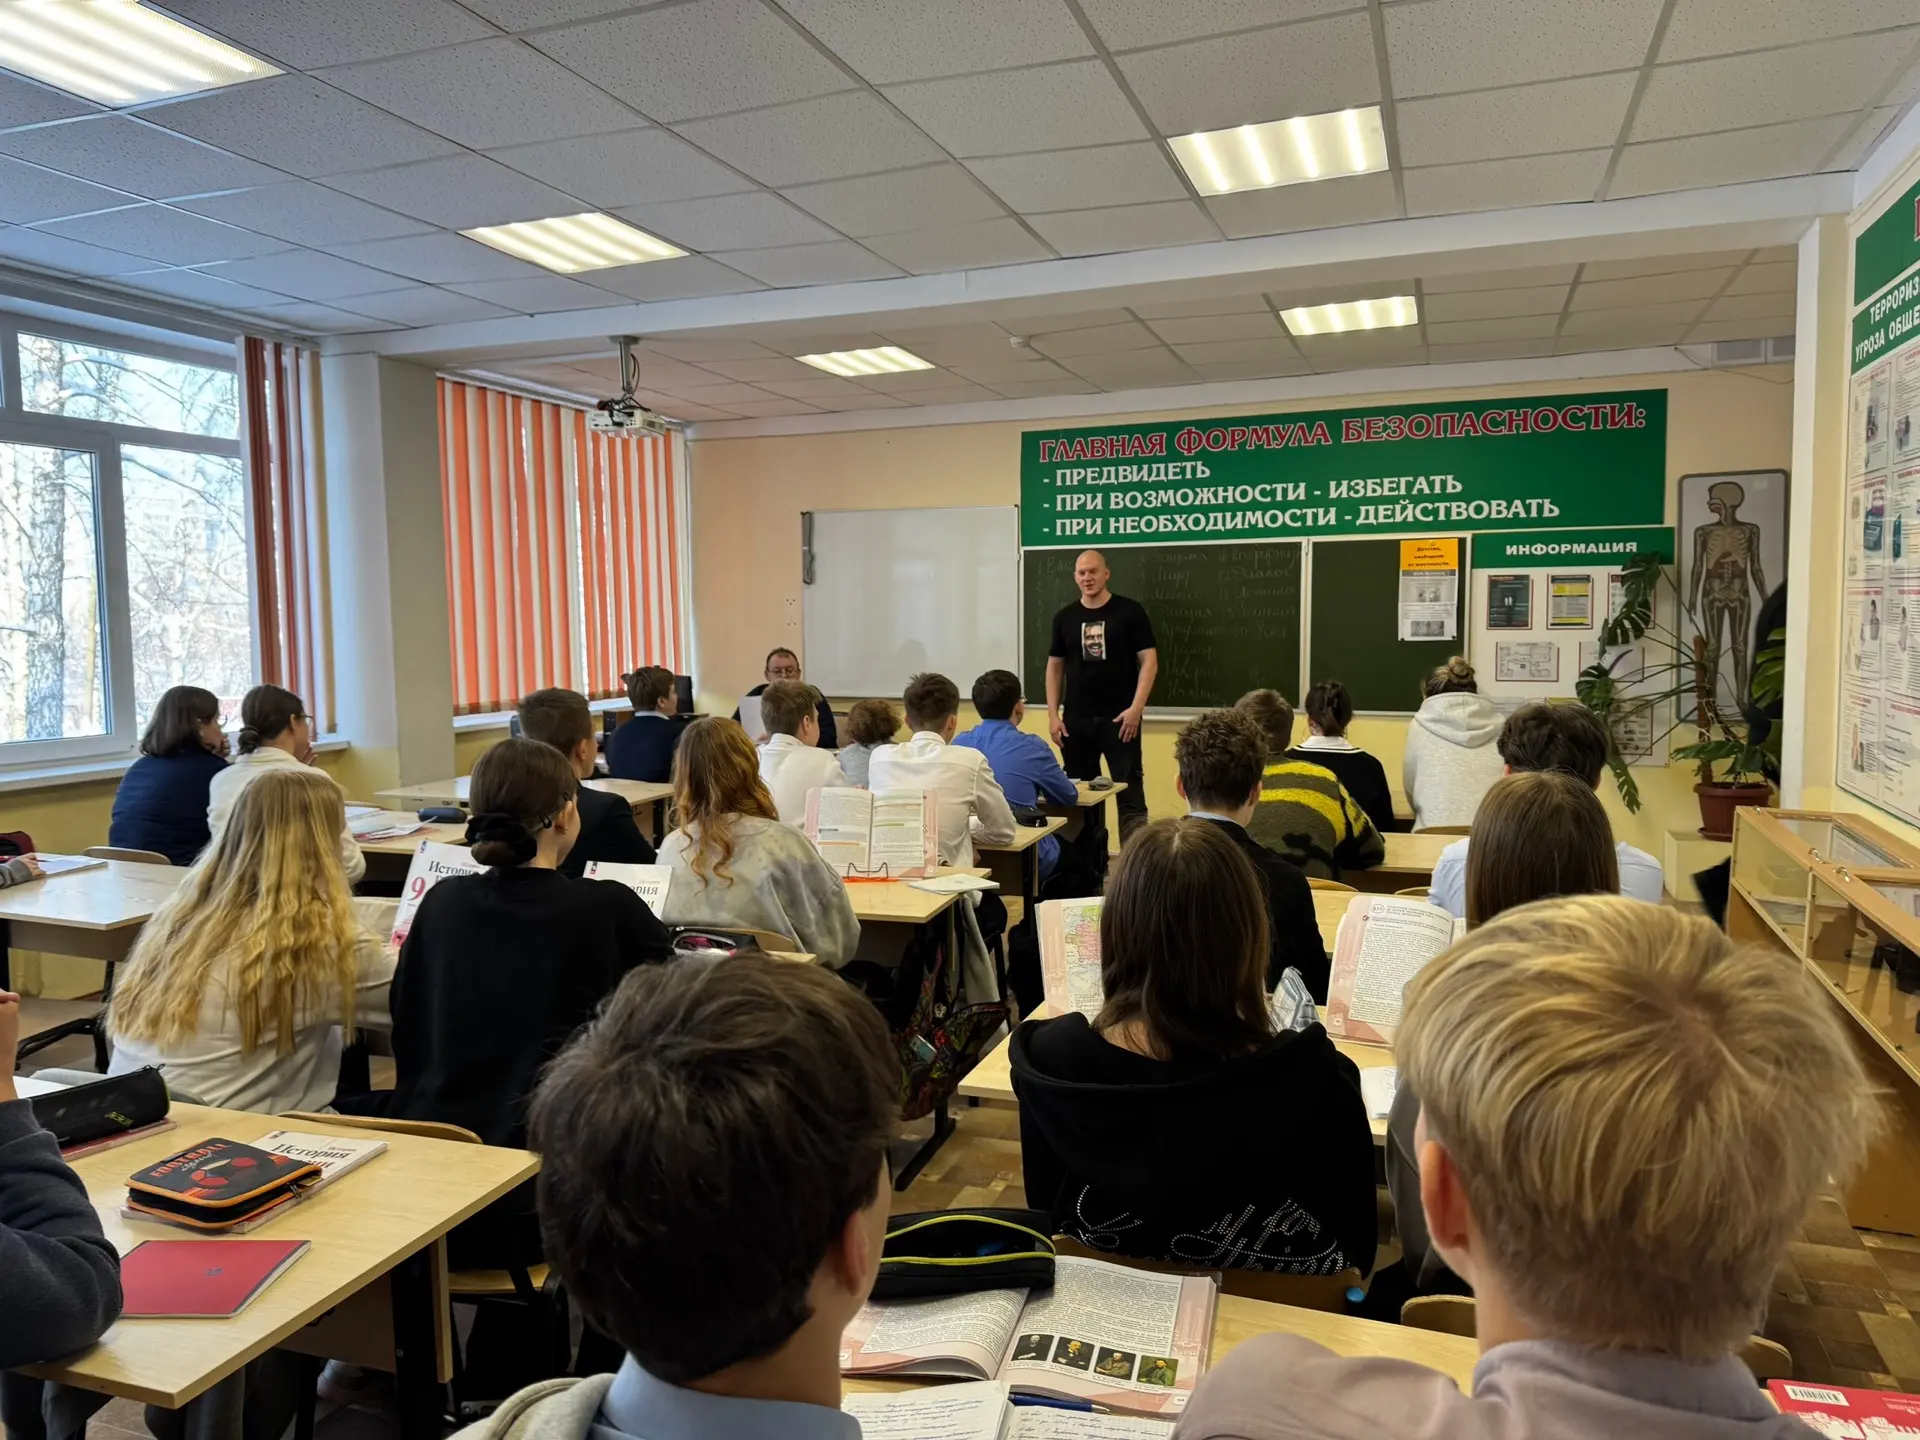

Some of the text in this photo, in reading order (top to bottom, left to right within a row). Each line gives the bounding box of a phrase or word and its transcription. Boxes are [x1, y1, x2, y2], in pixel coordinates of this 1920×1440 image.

[1870, 276, 1920, 324] ТЕРРОРИЗ
[1856, 329, 1885, 362] УГРОЗА
[1040, 402, 1646, 462] ГЛАВНАЯ ФОРМУЛА БЕЗОПАСНОСТИ:
[1056, 461, 1211, 486] ПРЕДВИДЕТЬ
[1055, 494, 1102, 511] ПРИ
[1109, 483, 1306, 510] ВОЗМОЖНОСТИ
[1329, 475, 1463, 499] ИЗБЕГАТЬ
[1055, 518, 1102, 535] ПРИ
[1109, 508, 1336, 534] НЕОБХОДИМОСТИ
[1356, 498, 1560, 526] ДЕЙСТВОВАТЬ
[1506, 542, 1637, 556] ИНФОРМАЦИЯ
[428, 860, 476, 876] Истори
[407, 876, 426, 901] 9
[271, 1143, 351, 1159] История
